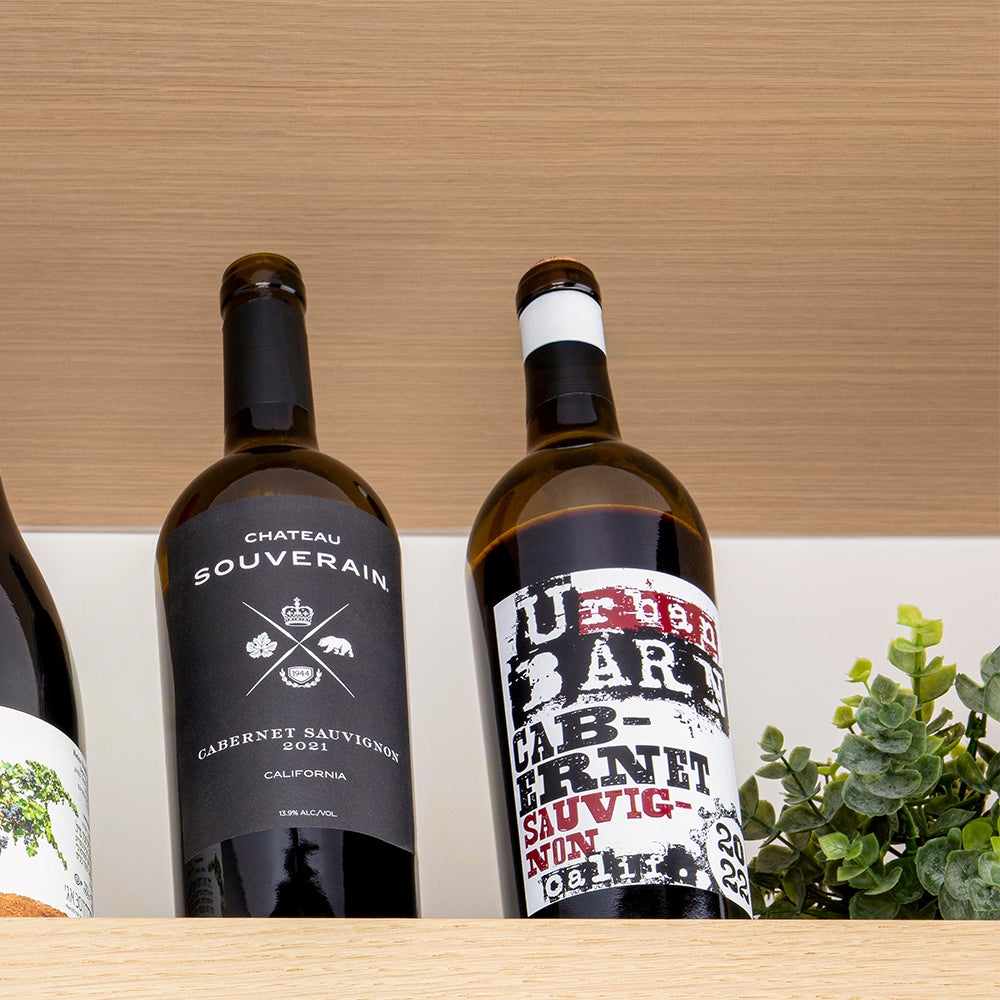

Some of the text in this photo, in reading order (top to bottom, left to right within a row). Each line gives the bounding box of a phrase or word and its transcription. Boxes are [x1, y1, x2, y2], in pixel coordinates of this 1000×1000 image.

[244, 529, 342, 546] CHATEAU
[291, 669, 310, 678] 1944
[512, 634, 727, 720] BARN
[197, 727, 400, 764] CABERNET SAUVIGNON
[282, 741, 328, 752] 2021
[512, 706, 651, 774] CAB-
[263, 769, 347, 781] CALIFORNIA
[518, 745, 711, 818] ERNET
[278, 809, 299, 817] 13.9%
[523, 786, 693, 850] SAUVIG-
[525, 828, 599, 879] NON
